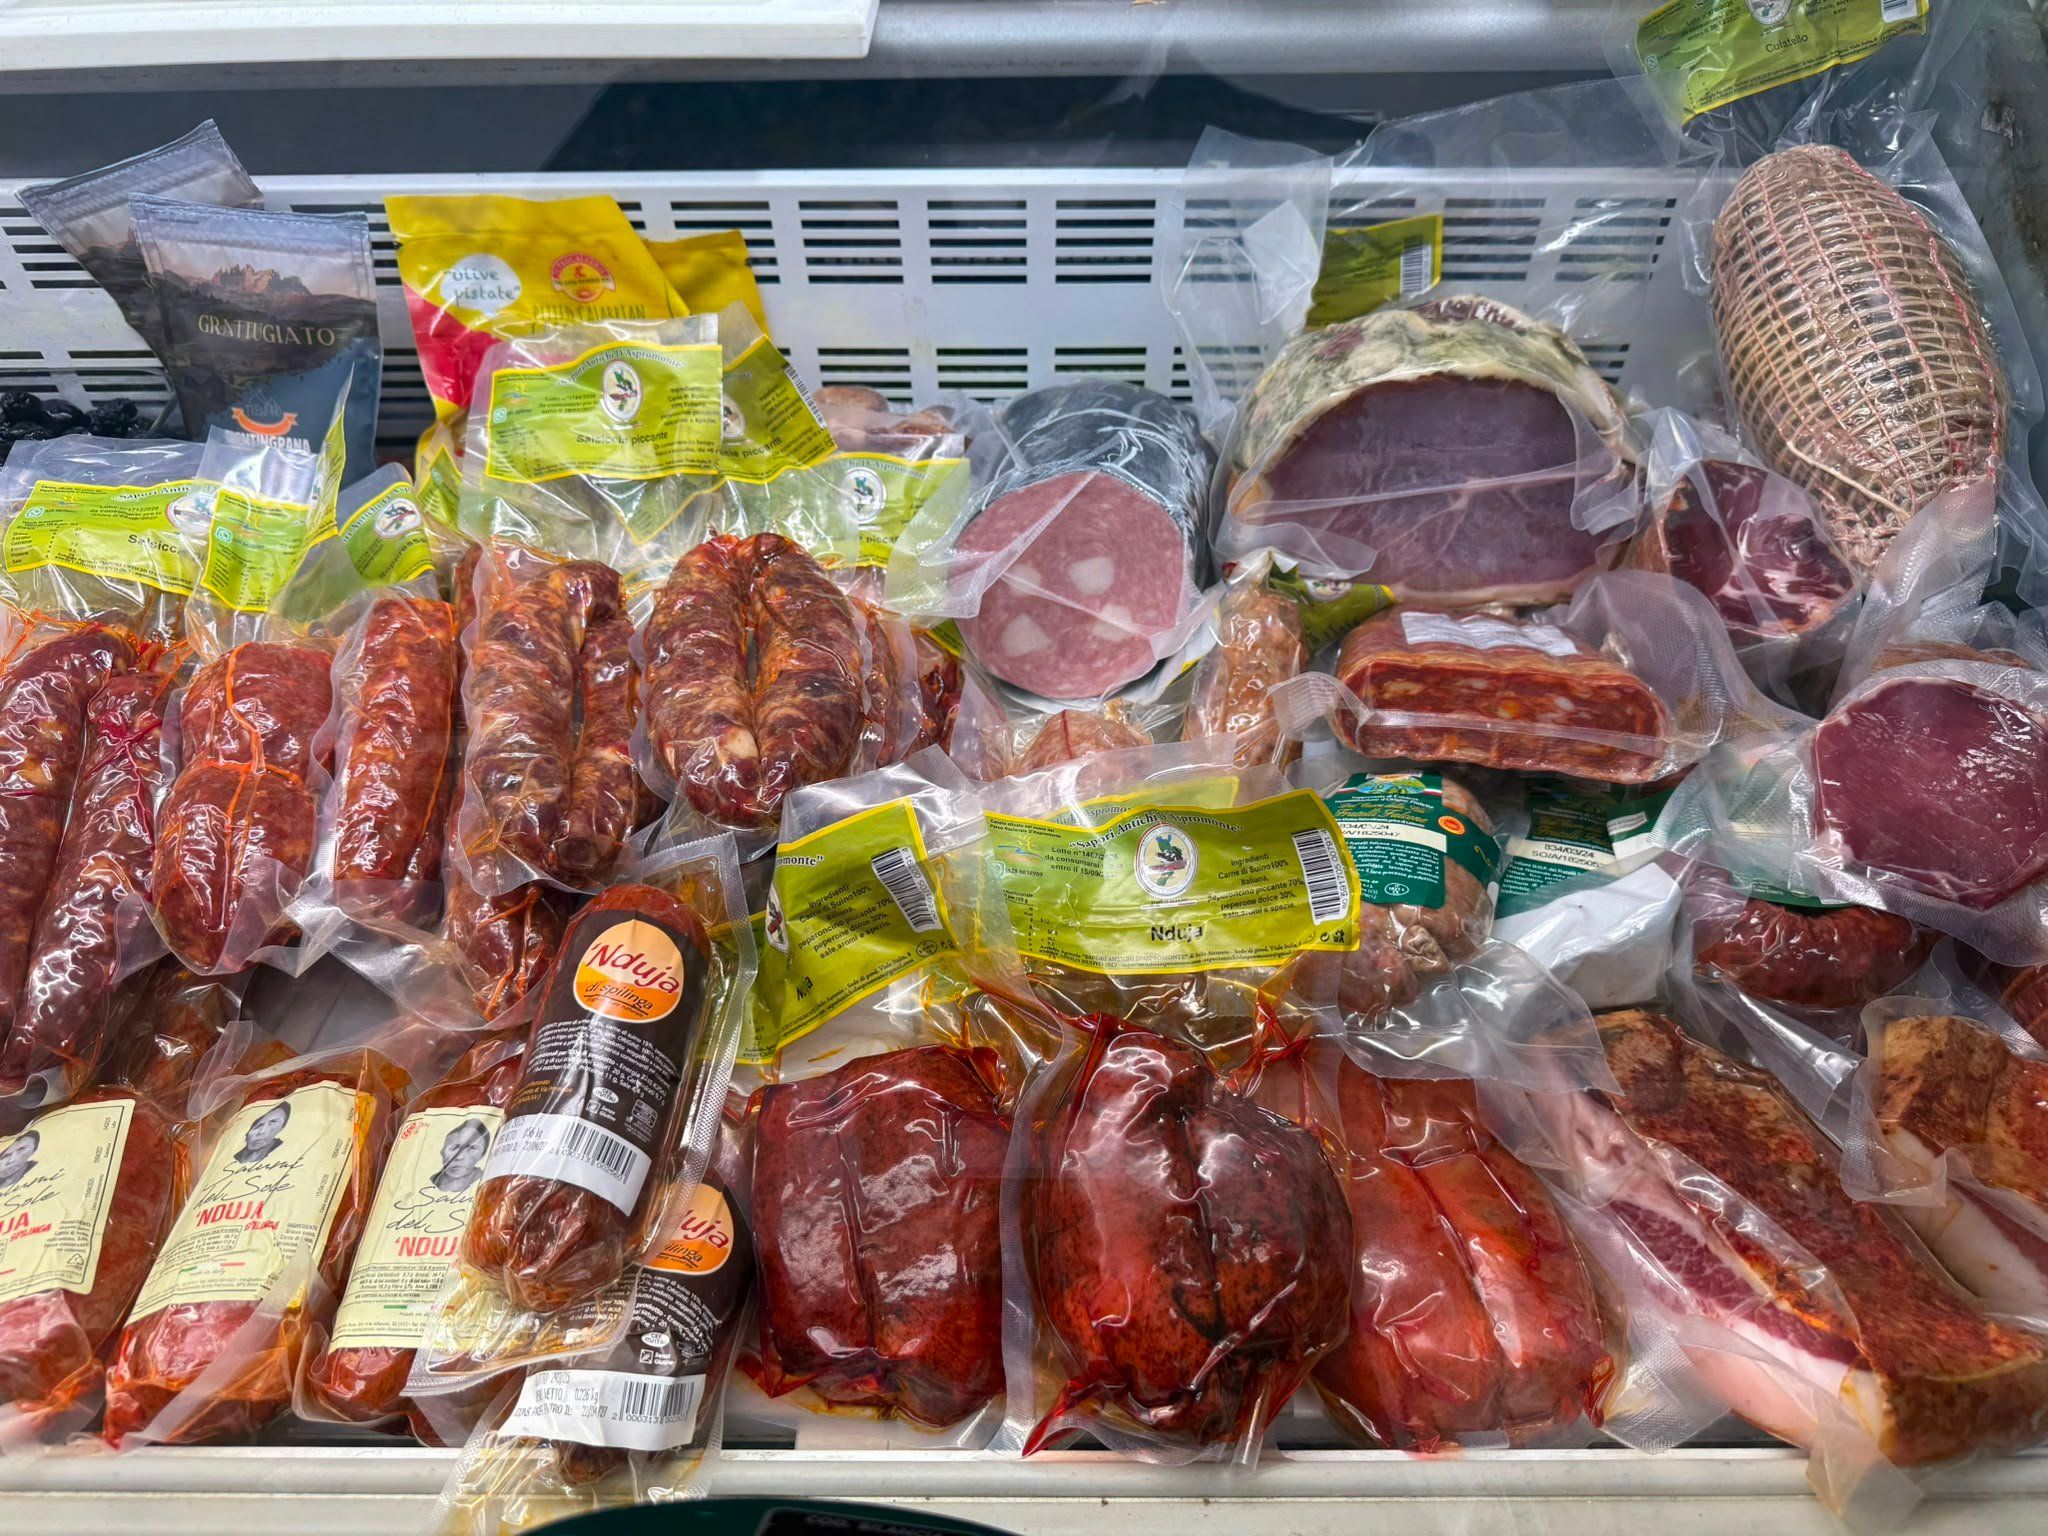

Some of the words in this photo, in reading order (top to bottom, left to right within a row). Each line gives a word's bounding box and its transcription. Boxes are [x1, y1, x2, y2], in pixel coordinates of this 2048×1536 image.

[1765, 33, 1809, 53] Culatello
[198, 313, 336, 347] GRATTUGIATO
[631, 430, 669, 446] piccante
[128, 534, 179, 554] Salsicc
[1069, 830, 1115, 851] "Sapori
[1116, 811, 1159, 838] Antichi
[1158, 811, 1245, 834] D'Aspromonte"
[1051, 846, 1072, 856] Lotto
[1051, 864, 1072, 872] entro
[1054, 856, 1100, 868] consumarsi
[1218, 870, 1239, 880] Carne
[1240, 866, 1248, 875] di
[1249, 859, 1289, 874] Suino100%
[1256, 882, 1288, 896] piccante
[1220, 898, 1256, 911] peperone
[1258, 894, 1279, 904] dolce
[800, 909, 822, 924] Carne
[798, 919, 845, 950] peperoncino
[813, 928, 850, 952] peperone
[1150, 923, 1203, 942] Nduja
[820, 936, 859, 959] sale,aromi
[585, 980, 602, 993] di
[600, 982, 654, 1011] spilinga
[618, 1078, 632, 1090] Sale
[0, 1168, 65, 1198] lumi
[393, 1185, 475, 1211] Salu
[395, 1236, 461, 1257] 'NDUJ
[664, 1243, 704, 1263] ilinga
[590, 1388, 599, 1403] kg
